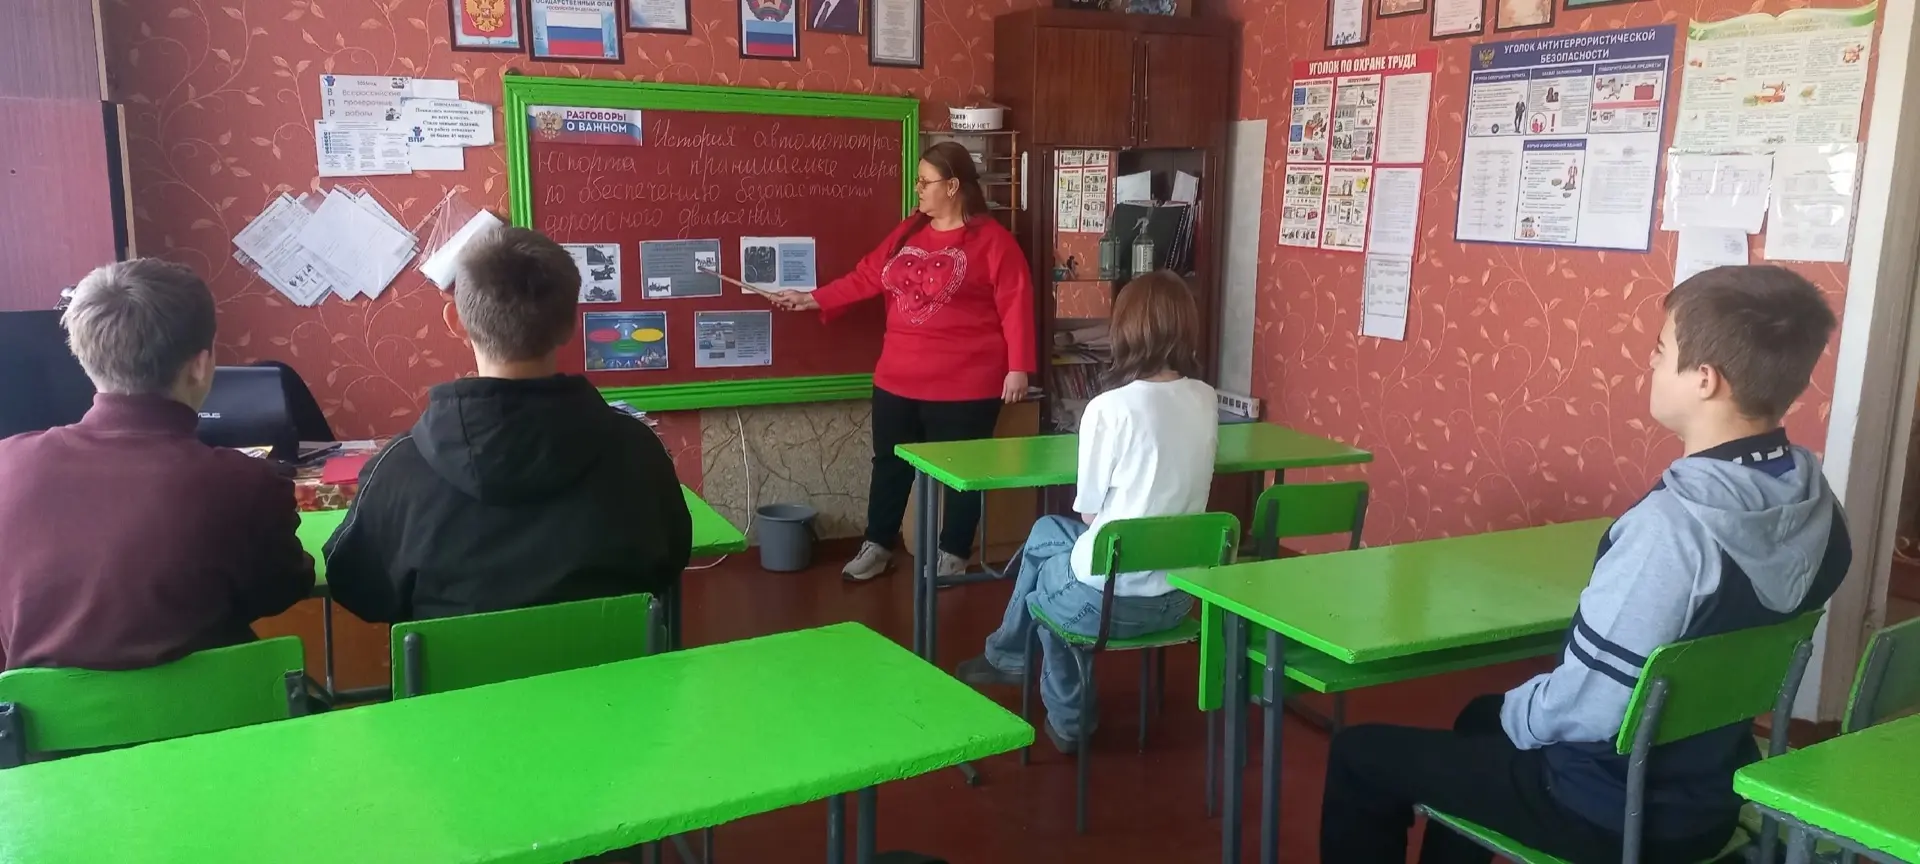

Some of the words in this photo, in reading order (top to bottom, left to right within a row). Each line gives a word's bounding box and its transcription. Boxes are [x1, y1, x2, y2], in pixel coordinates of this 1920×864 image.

[1504, 43, 1535, 54] УГОЛОК
[1537, 29, 1656, 51] АНТИТЕРРОРИСТИЧЕСКОЙ
[1309, 60, 1339, 75] УГОЛОК
[1341, 59, 1352, 73] ПО
[1353, 56, 1386, 71] ОХРАНЕ
[1388, 53, 1417, 69] ТРУДА
[1540, 49, 1610, 63] БЕЗОПАСНОСТИ
[566, 110, 627, 121] РАЗГОВОРЫ
[566, 121, 575, 131] О
[578, 121, 627, 133] ВАЖНОМ
[652, 118, 736, 158] История
[657, 159, 670, 176] и
[690, 152, 838, 187] принимаемые
[853, 158, 899, 182] меры
[545, 183, 565, 205] по
[579, 176, 720, 204] обеспечению
[736, 177, 873, 211] безопастности
[545, 208, 663, 243] дорожного
[678, 203, 788, 239] движения
